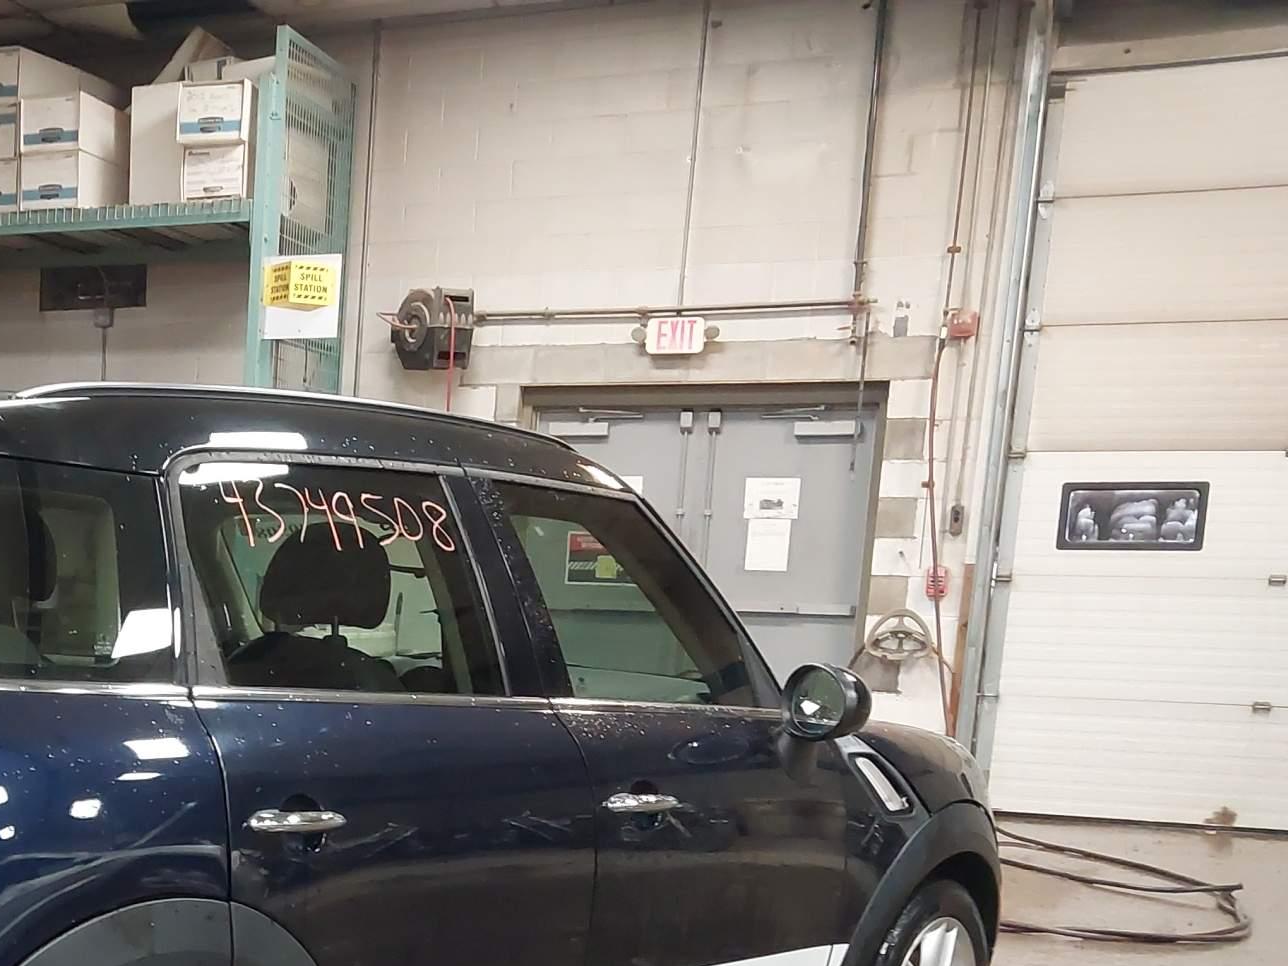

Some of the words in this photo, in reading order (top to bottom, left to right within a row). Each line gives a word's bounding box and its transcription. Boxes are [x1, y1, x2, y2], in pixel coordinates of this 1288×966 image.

[300, 272, 323, 282] SPILL
[294, 283, 328, 293] STATION
[655, 319, 697, 352] EXIT
[219, 478, 455, 552] 43749508
